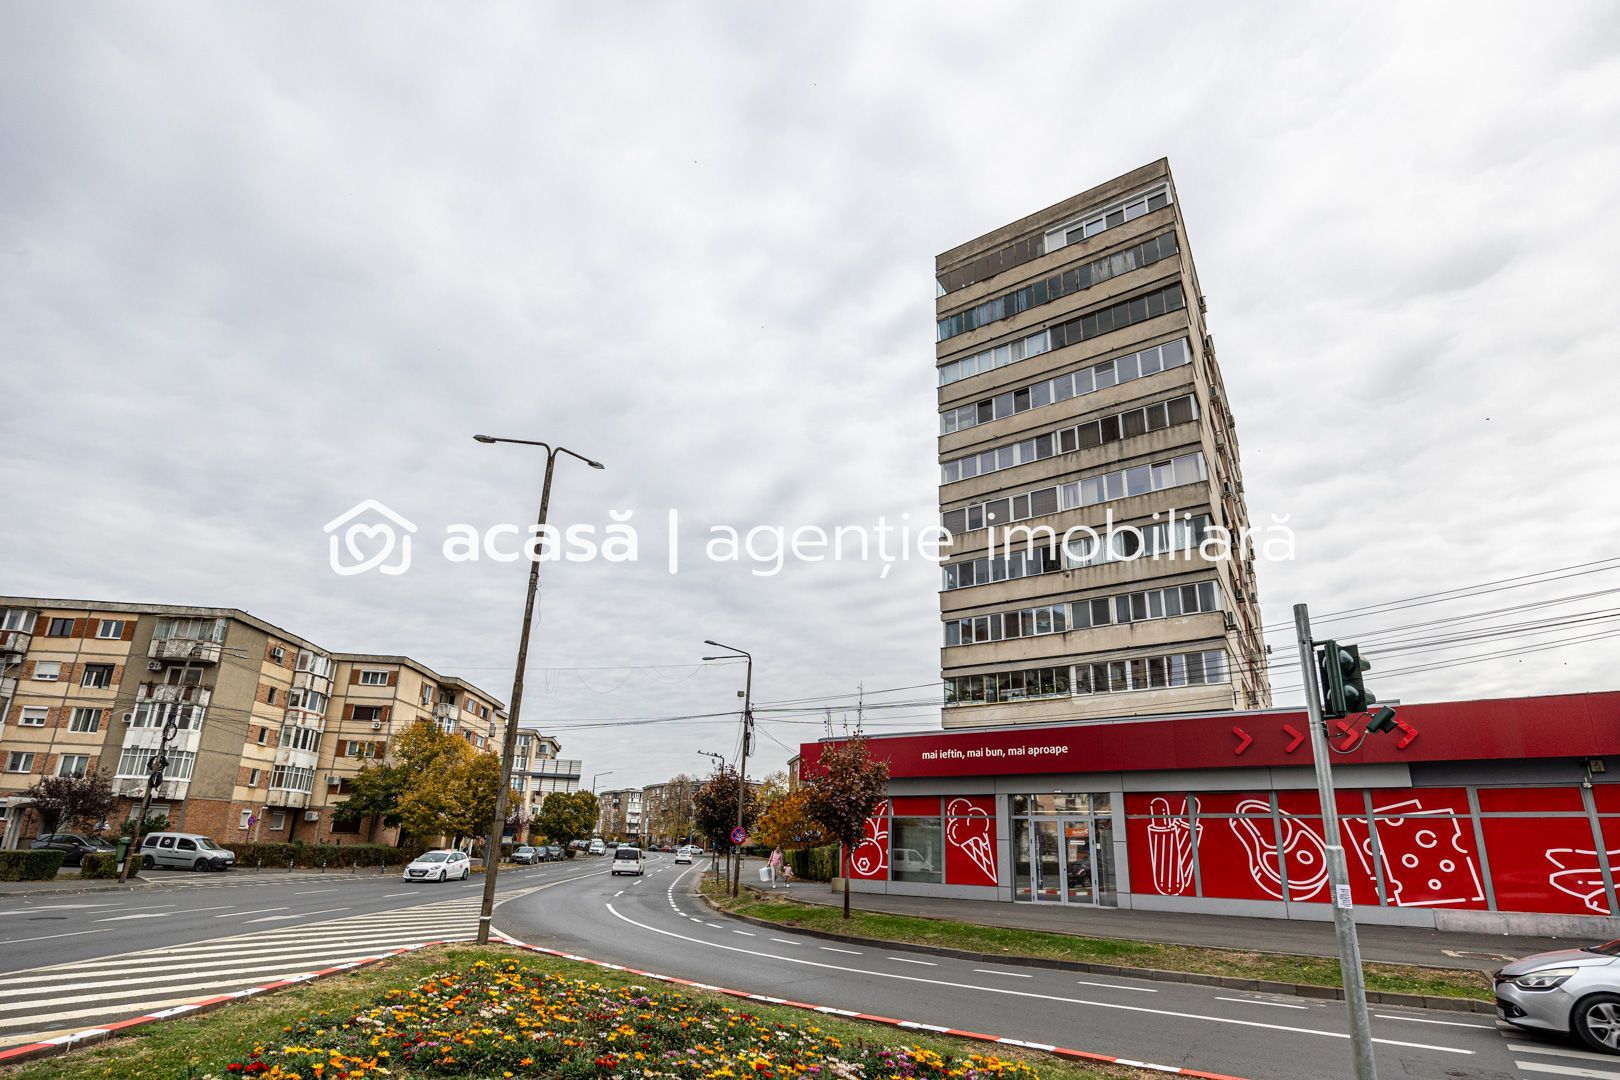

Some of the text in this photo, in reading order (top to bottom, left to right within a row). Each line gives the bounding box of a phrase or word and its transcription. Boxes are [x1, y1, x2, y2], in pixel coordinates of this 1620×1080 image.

[922, 745, 1068, 760] mai ieftin, mai bun, mai aproape
